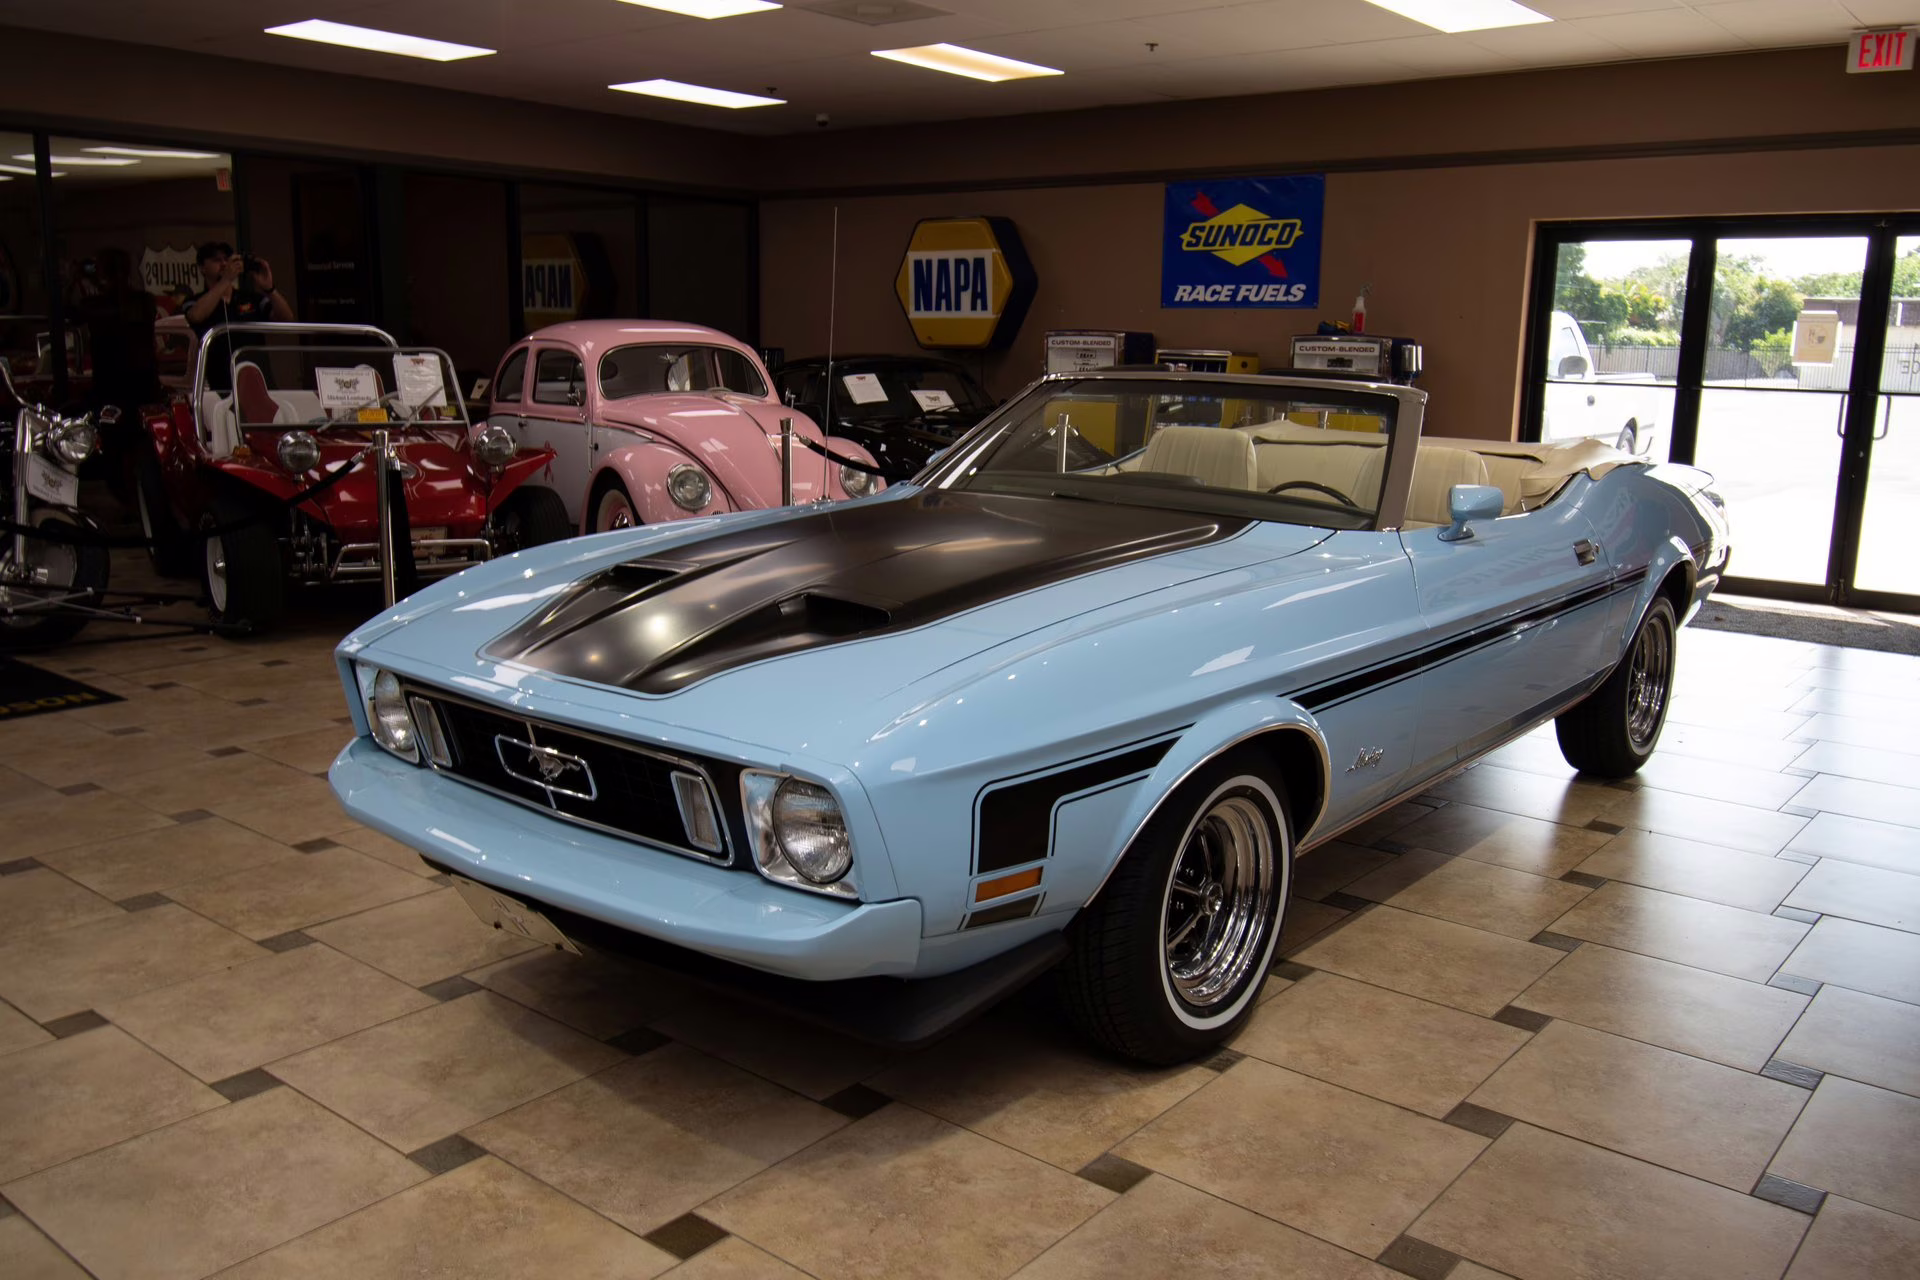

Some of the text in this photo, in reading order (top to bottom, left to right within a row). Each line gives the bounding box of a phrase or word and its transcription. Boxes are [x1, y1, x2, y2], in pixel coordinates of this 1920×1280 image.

[1858, 32, 1908, 69] EXIT
[1185, 222, 1298, 248] SUNOCO
[914, 258, 988, 311] NAPA
[1174, 283, 1307, 302] RACE FUELS
